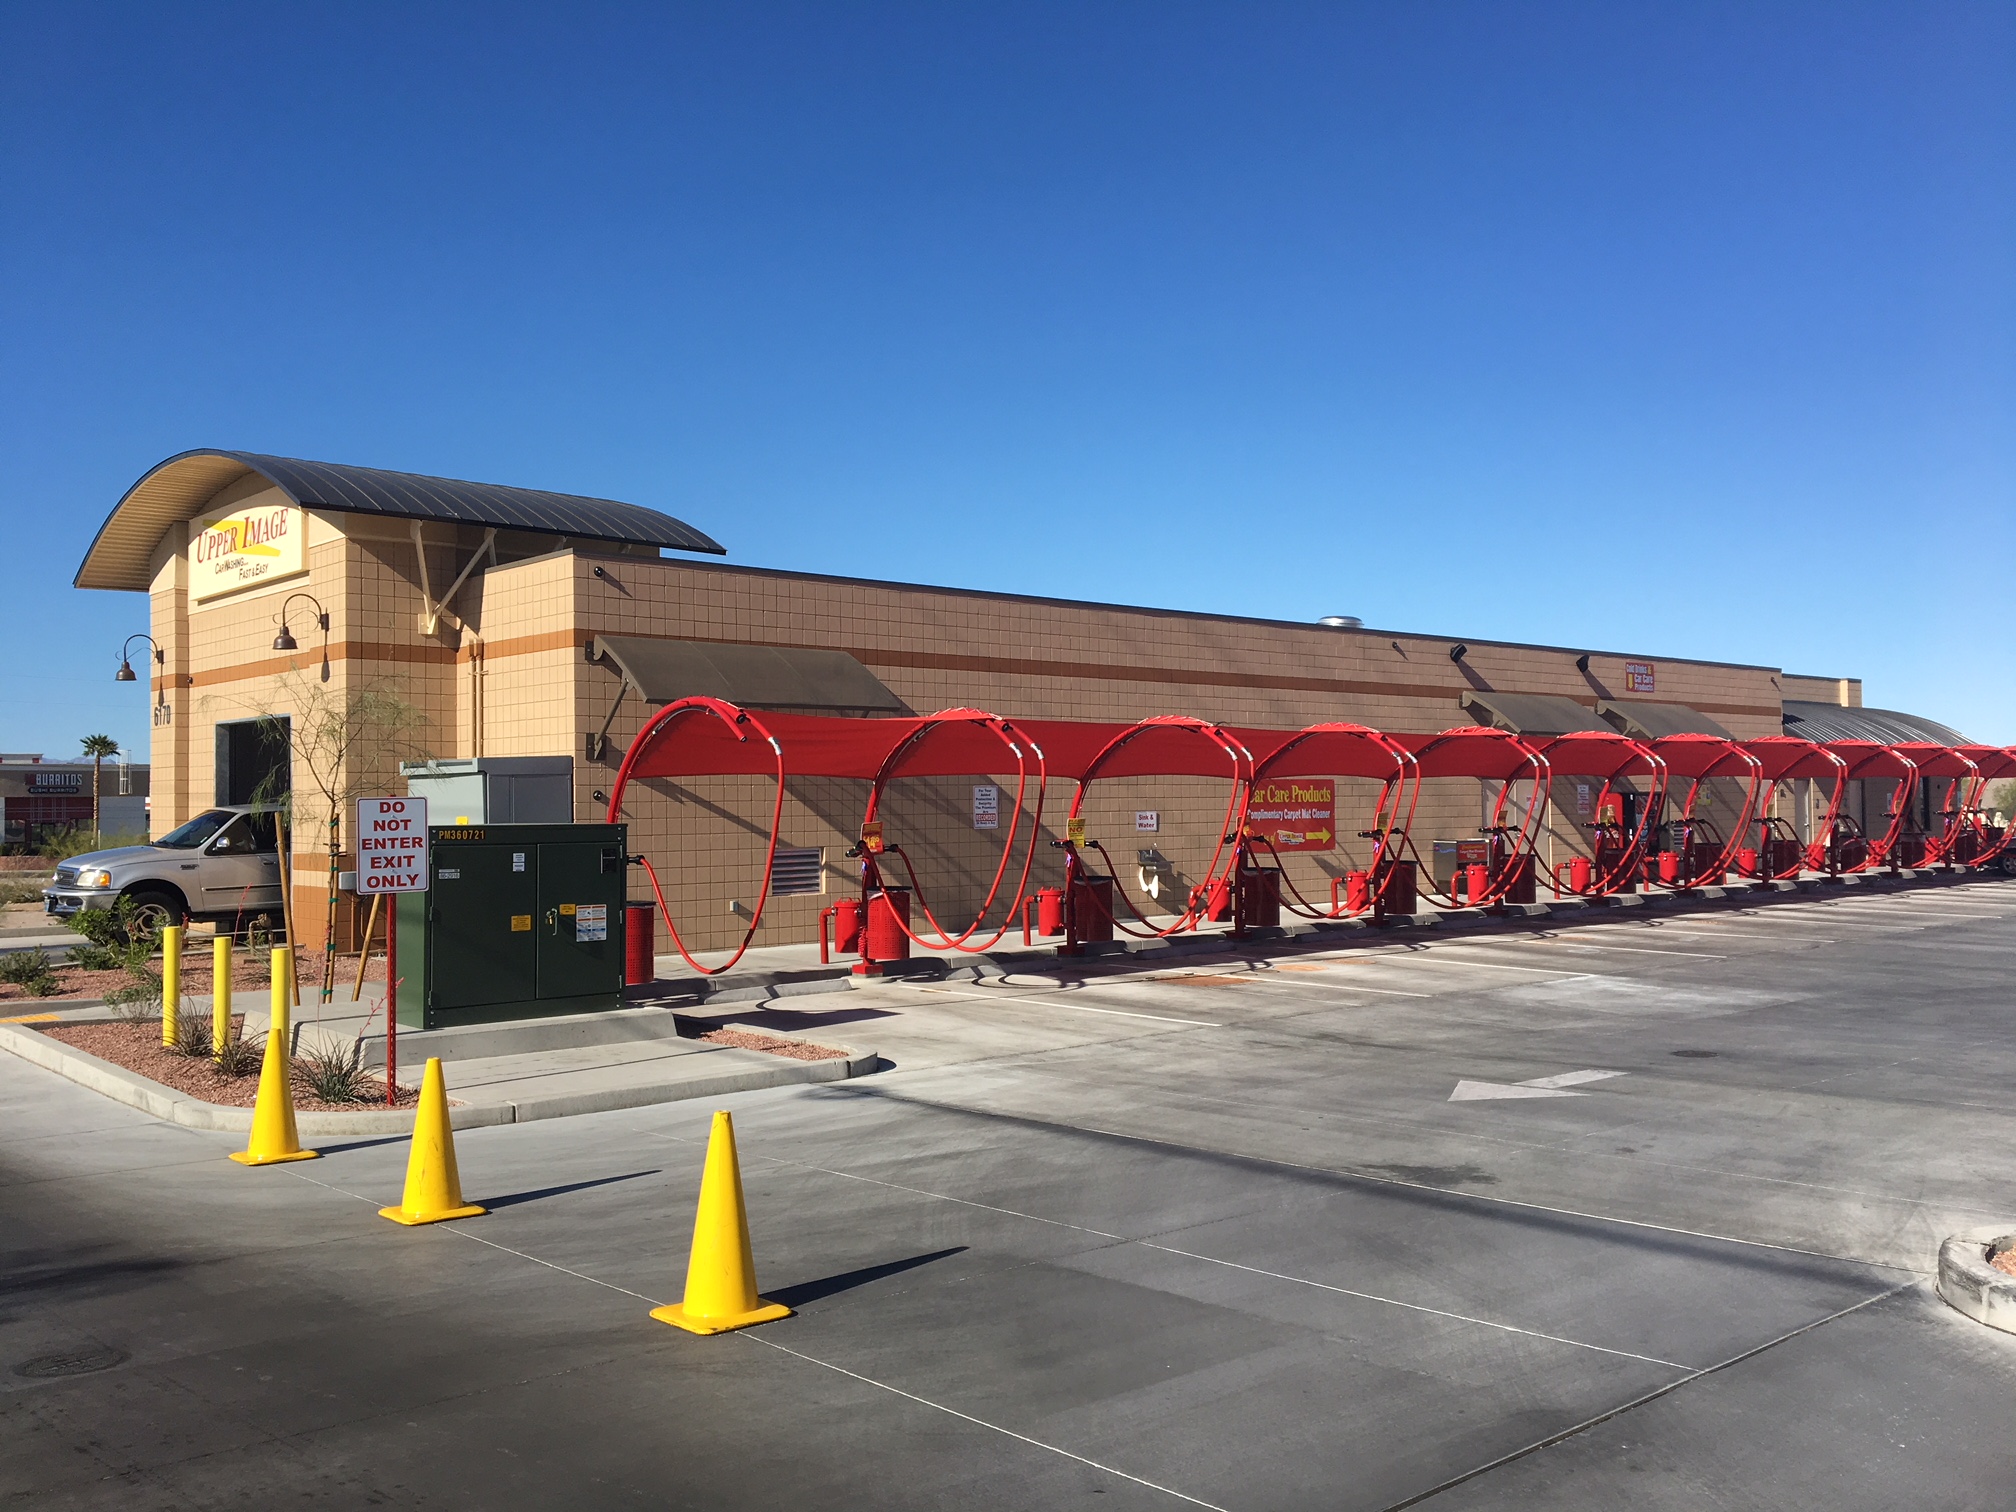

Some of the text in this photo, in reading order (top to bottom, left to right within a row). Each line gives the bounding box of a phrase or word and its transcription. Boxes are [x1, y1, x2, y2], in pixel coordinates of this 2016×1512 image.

[197, 507, 289, 563] UPPER IMAGE
[154, 704, 171, 727] 6170
[1267, 784, 1290, 803] Care
[1291, 784, 1332, 803] Products
[379, 801, 406, 814] DO
[1283, 808, 1301, 822] Carpet
[1311, 808, 1331, 819] Cleaner
[373, 819, 412, 832] NOT
[439, 830, 485, 840] PM360721
[361, 836, 424, 851] ENTER
[370, 855, 416, 869] EXIT
[366, 873, 420, 889] ONLY
